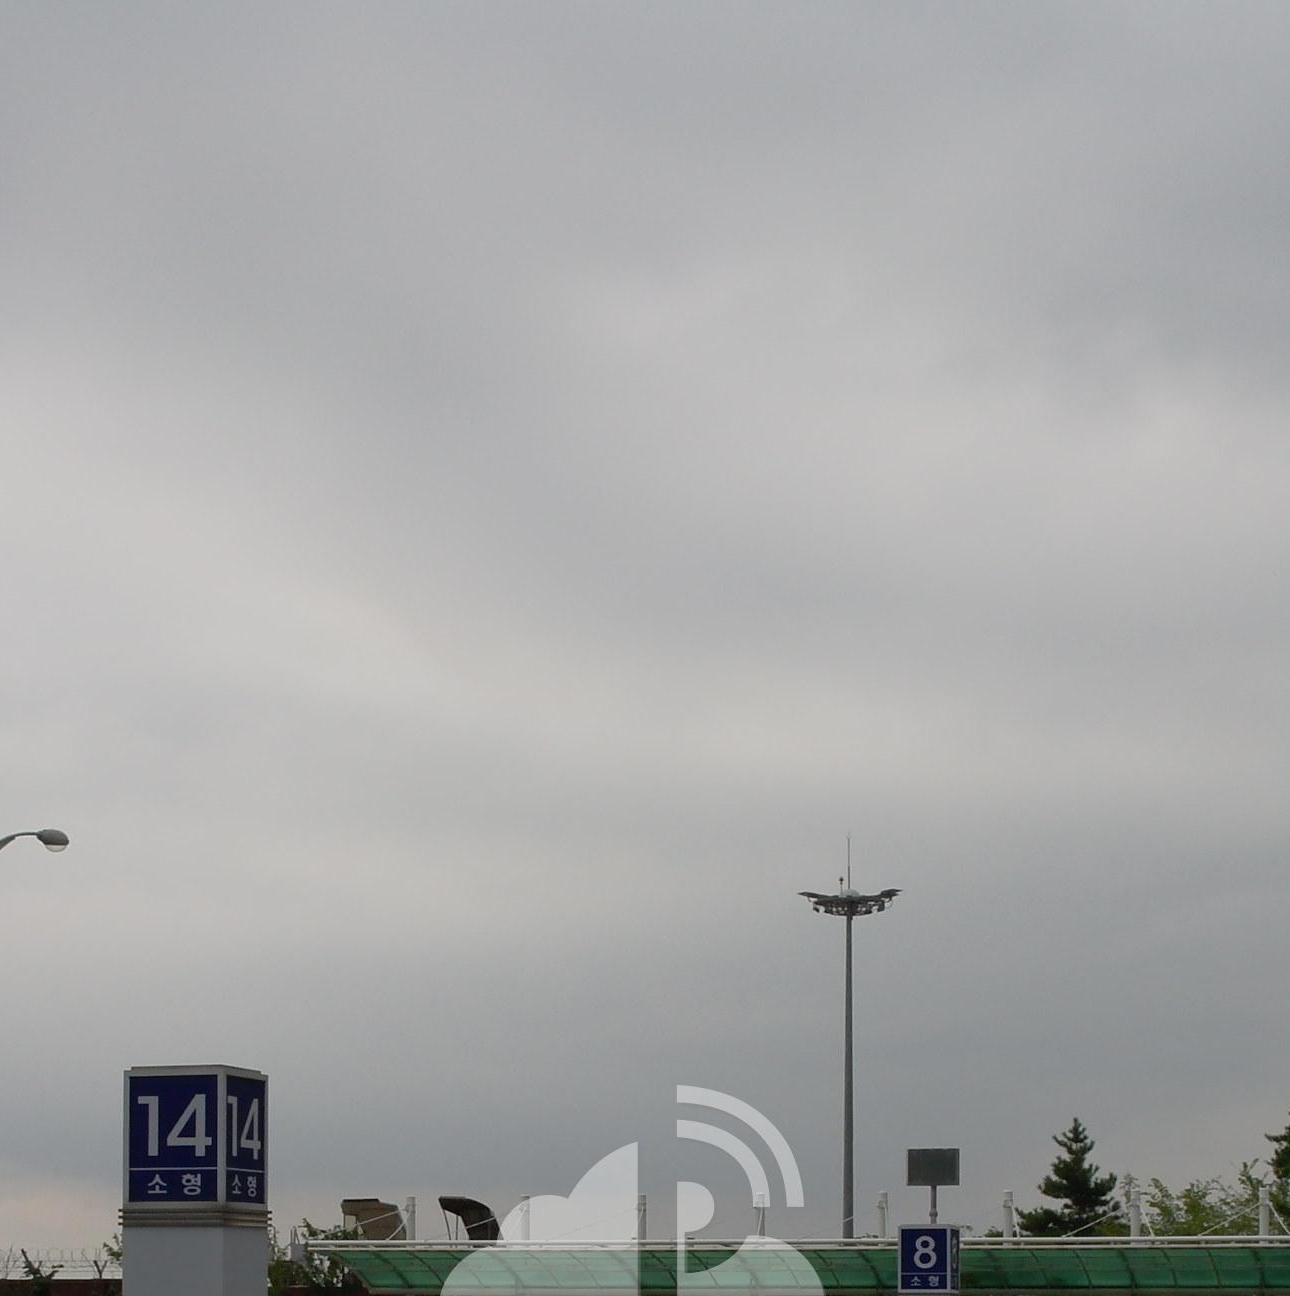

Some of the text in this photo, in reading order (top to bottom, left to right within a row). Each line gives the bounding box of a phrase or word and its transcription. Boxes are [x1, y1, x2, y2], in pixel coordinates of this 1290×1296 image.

[137, 1093, 213, 1157] 14
[227, 1095, 262, 1161] 14
[913, 1235, 937, 1270] 8
